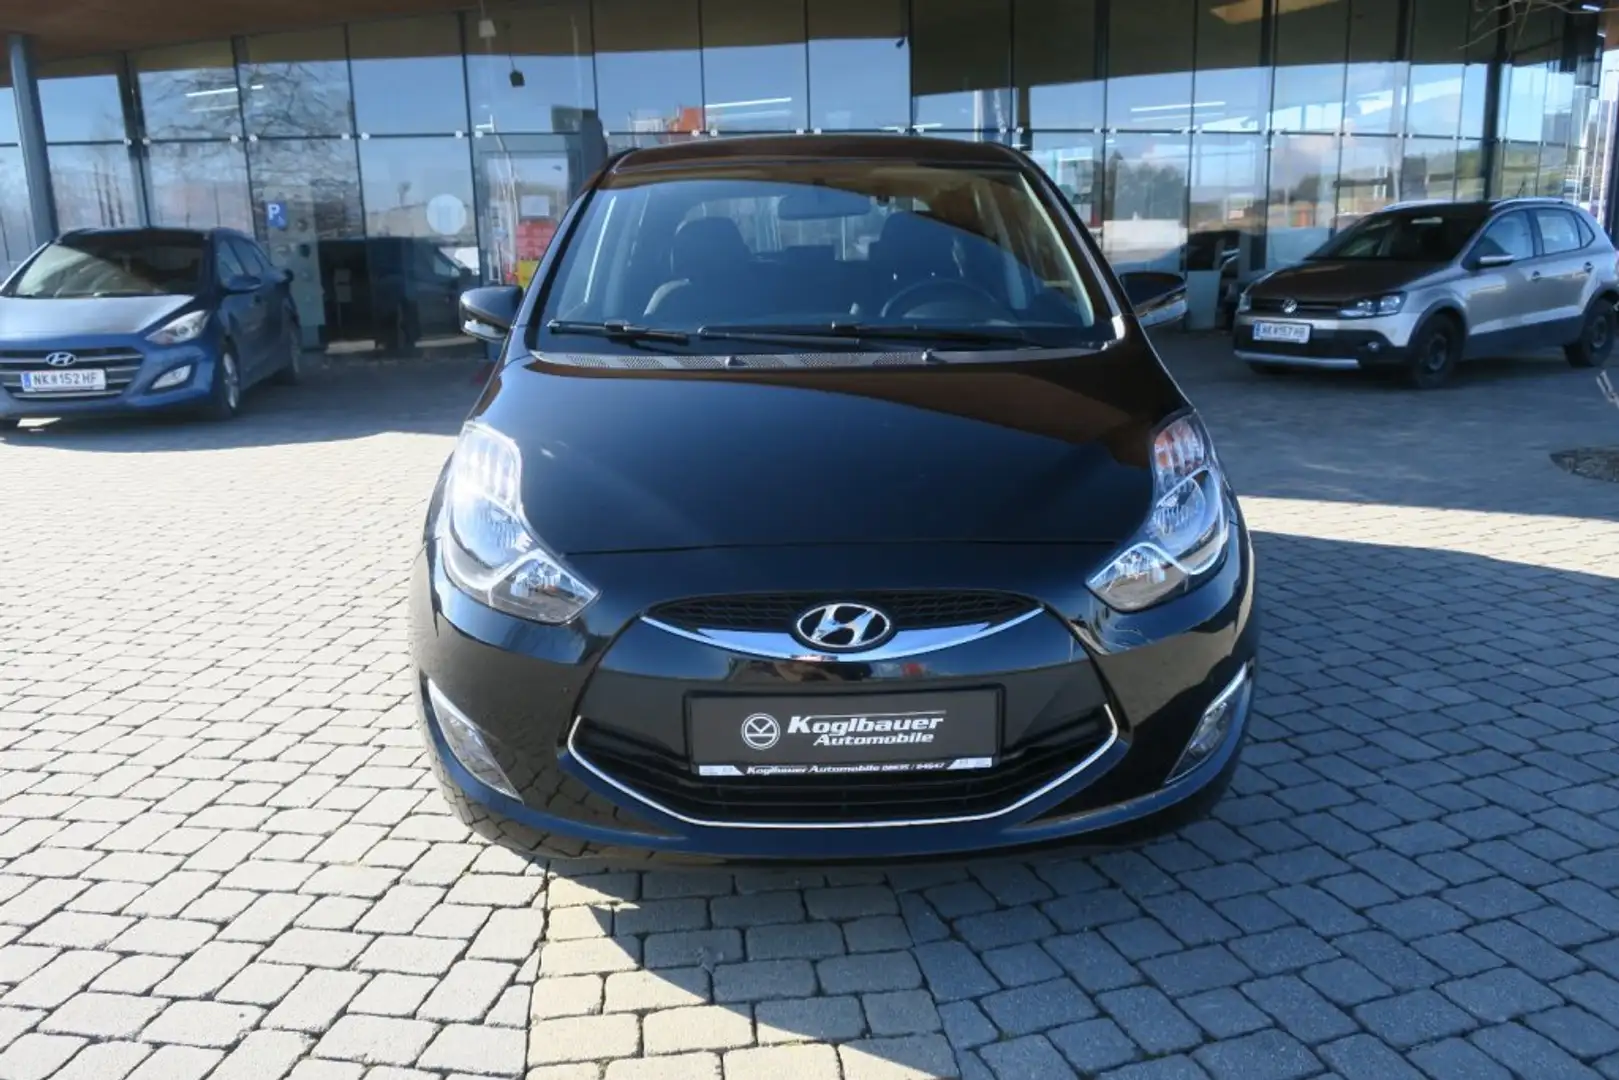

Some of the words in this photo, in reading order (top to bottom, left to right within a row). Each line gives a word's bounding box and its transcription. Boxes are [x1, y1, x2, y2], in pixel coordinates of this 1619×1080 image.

[267, 203, 281, 221] P
[33, 373, 49, 386] NK
[59, 372, 80, 385] 152
[787, 713, 944, 737] Koglbauer
[813, 731, 935, 747] Automobile
[746, 764, 807, 776] Koglbauer
[807, 763, 880, 774] Automobile
